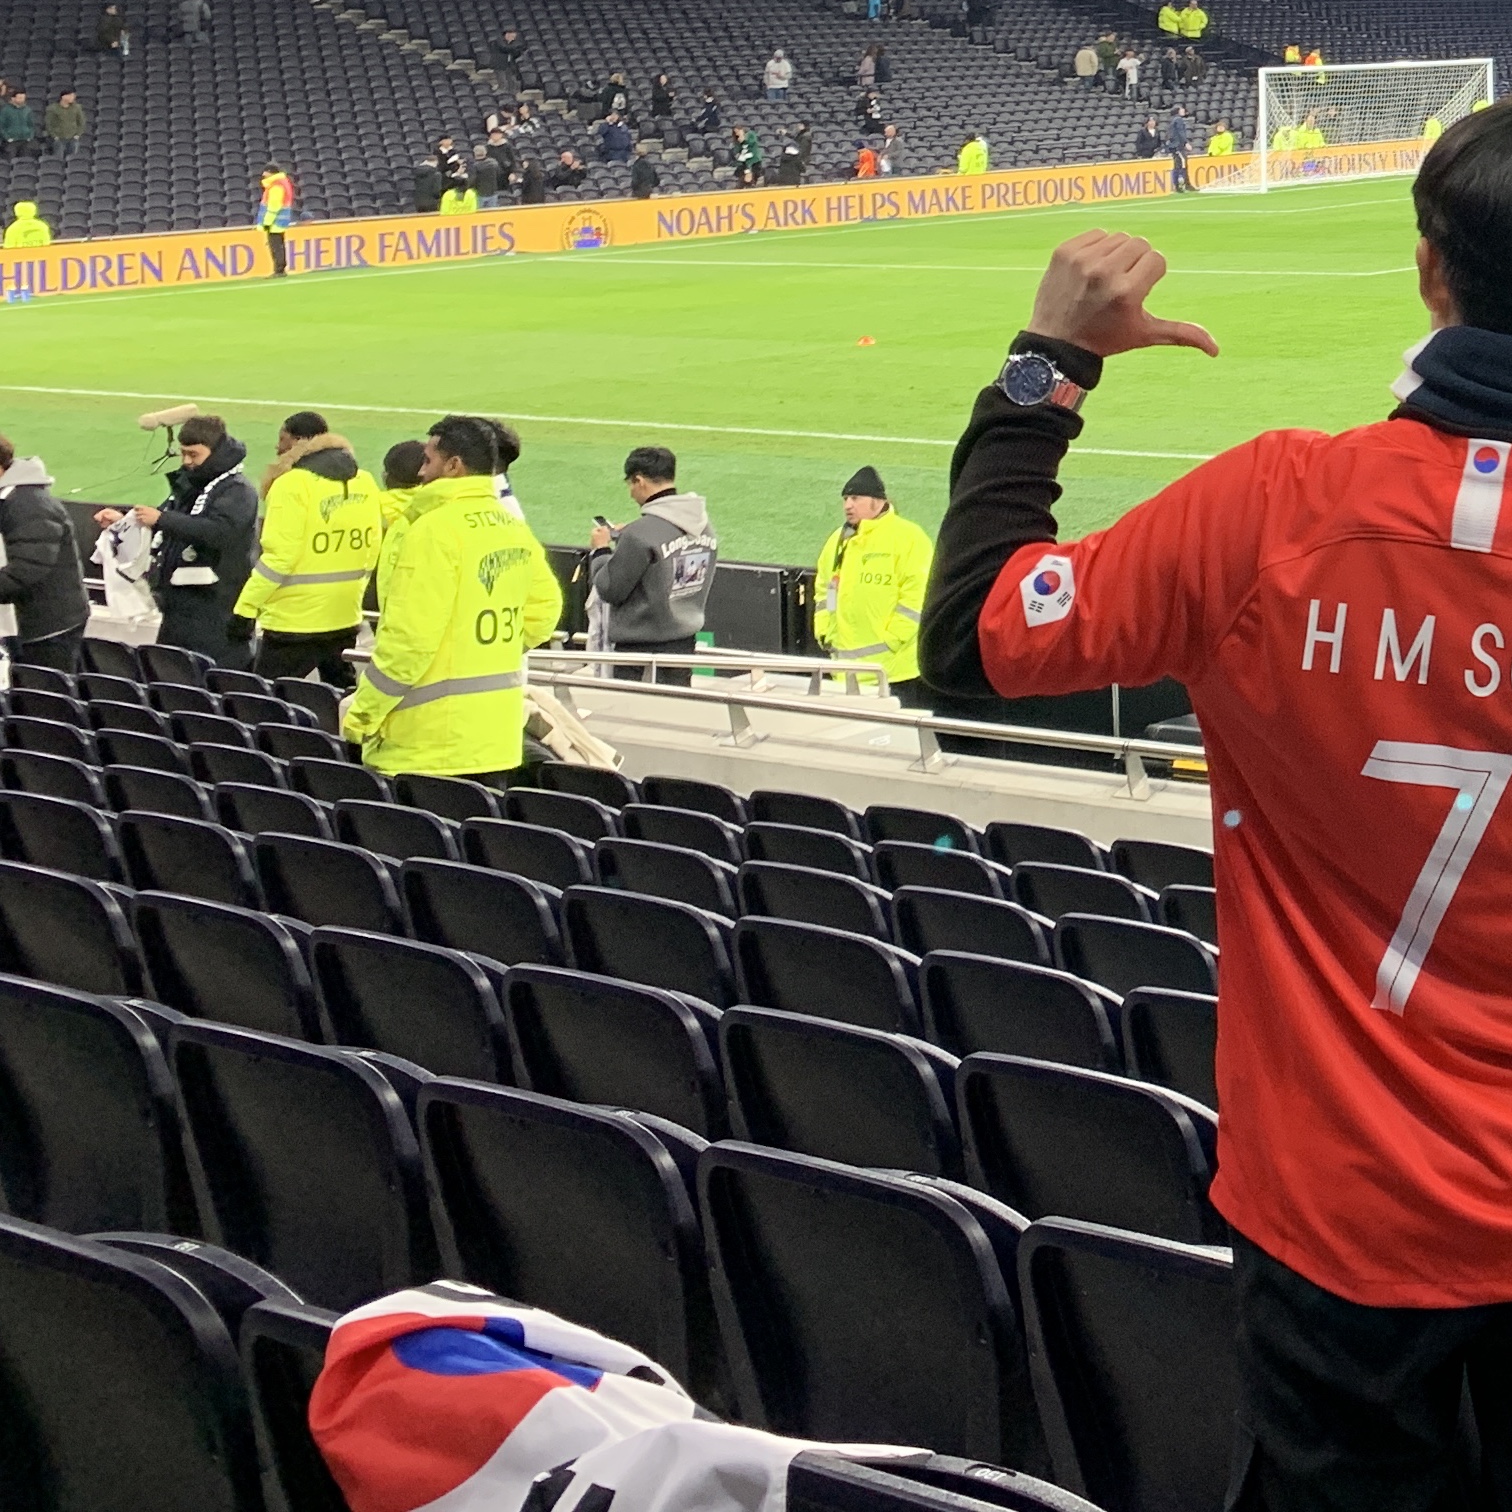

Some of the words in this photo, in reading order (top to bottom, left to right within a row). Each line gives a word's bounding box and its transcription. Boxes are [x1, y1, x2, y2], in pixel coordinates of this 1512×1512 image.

[657, 202, 756, 239] NOAH'S
[764, 197, 817, 229] ARK
[826, 191, 900, 223] HELPS
[907, 185, 975, 215] MAKE
[981, 175, 1085, 208] PRECIOUS
[176, 243, 255, 281] AND
[287, 234, 370, 271] HEIR
[378, 221, 515, 263] FAMILIES
[859, 572, 892, 586] 1092
[1301, 598, 1347, 674] H
[1372, 607, 1436, 686] M
